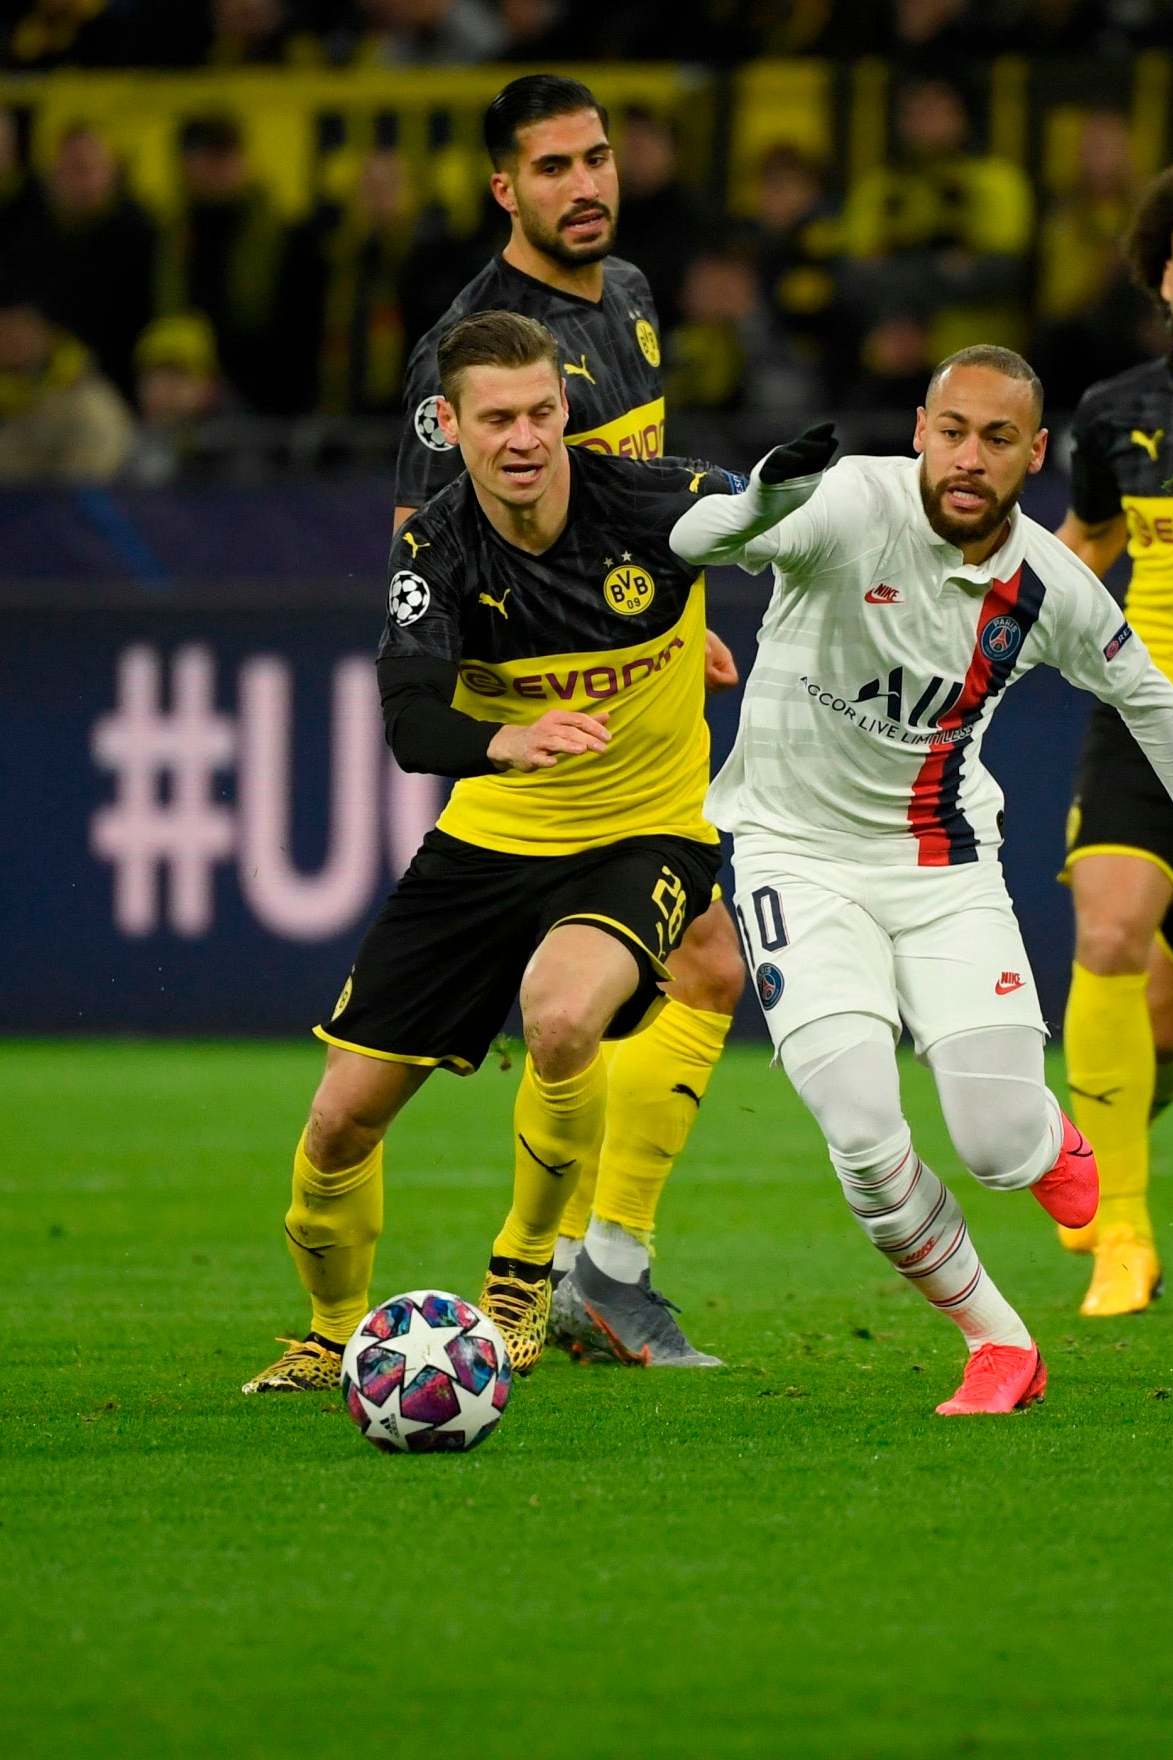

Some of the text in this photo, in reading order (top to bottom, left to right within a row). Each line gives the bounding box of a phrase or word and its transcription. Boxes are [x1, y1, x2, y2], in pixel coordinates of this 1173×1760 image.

[618, 419, 664, 459] EVO
[610, 570, 649, 603] BVB
[873, 583, 900, 601] NIKE
[626, 597, 642, 609] 09
[992, 618, 1018, 633] PARIS
[800, 676, 974, 746] ACCOR LIVE LIMITLESS
[1000, 971, 1020, 984] NIKE
